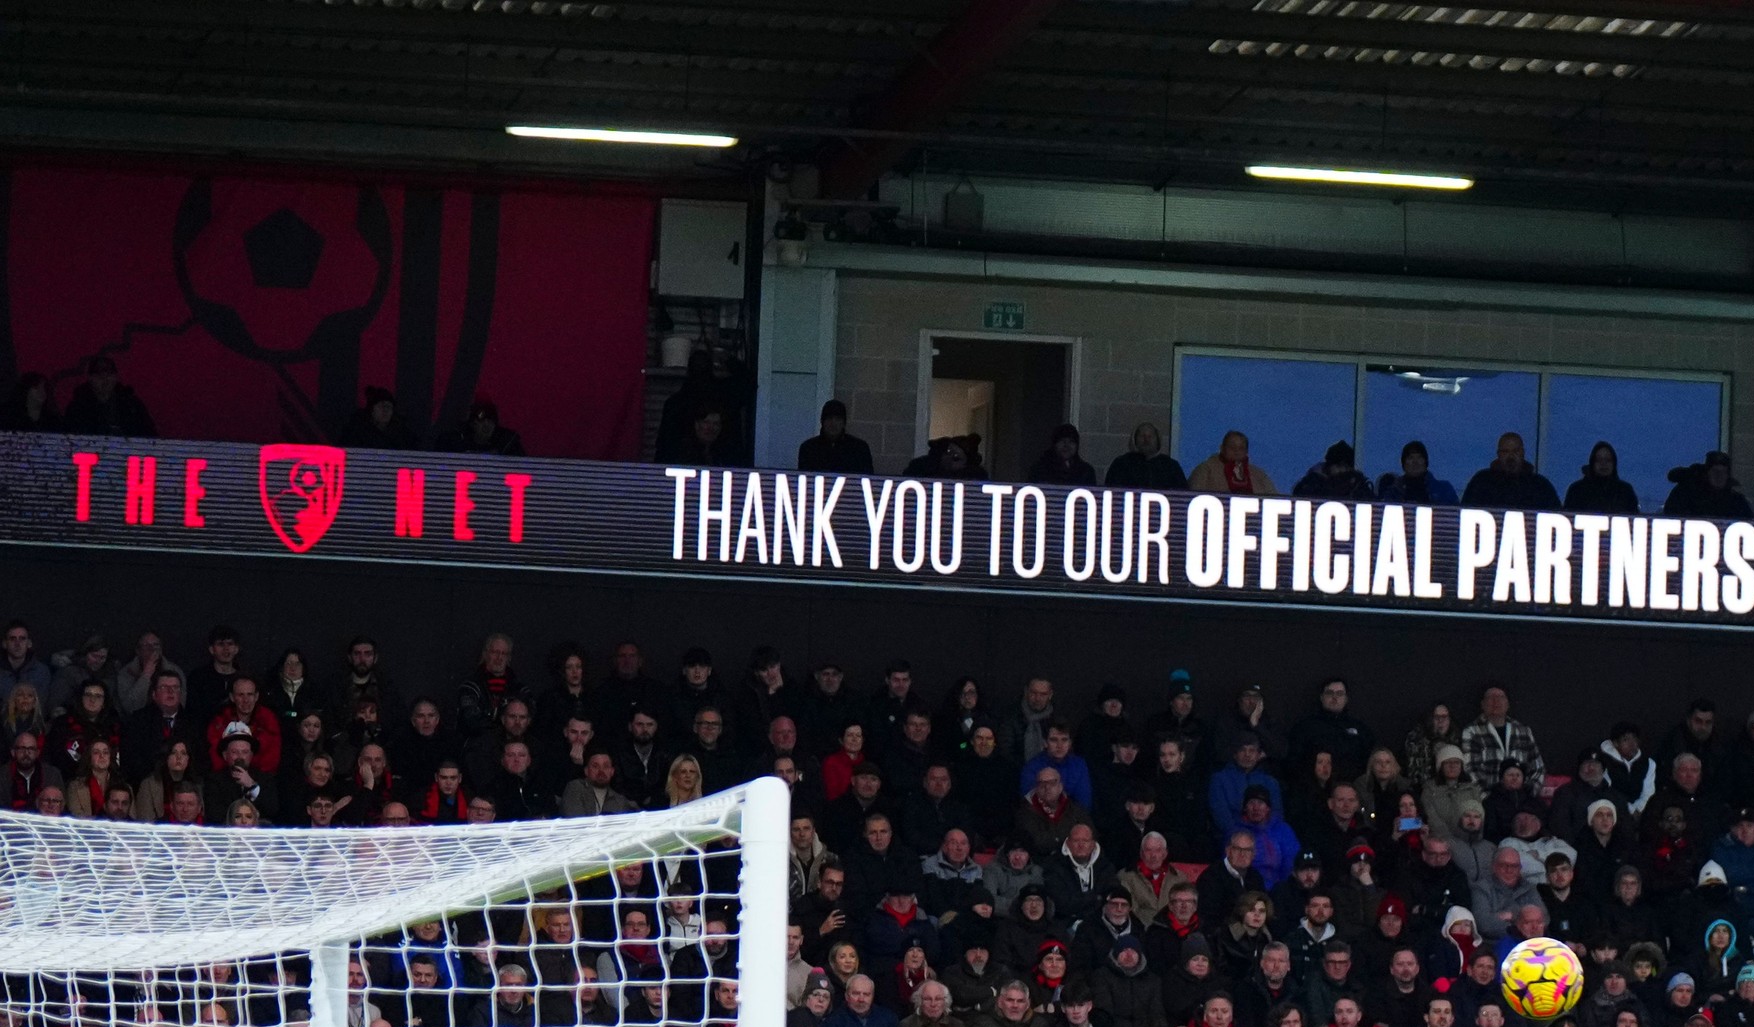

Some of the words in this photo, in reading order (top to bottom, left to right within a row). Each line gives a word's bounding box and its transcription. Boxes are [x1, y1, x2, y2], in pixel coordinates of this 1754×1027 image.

[73, 452, 207, 528] THE
[395, 467, 533, 543] NET
[665, 467, 844, 568] THANK
[861, 477, 964, 575] YOU
[982, 484, 1047, 579] TO
[1063, 487, 1171, 584] OUR
[1185, 494, 1443, 599] OFFICIAL
